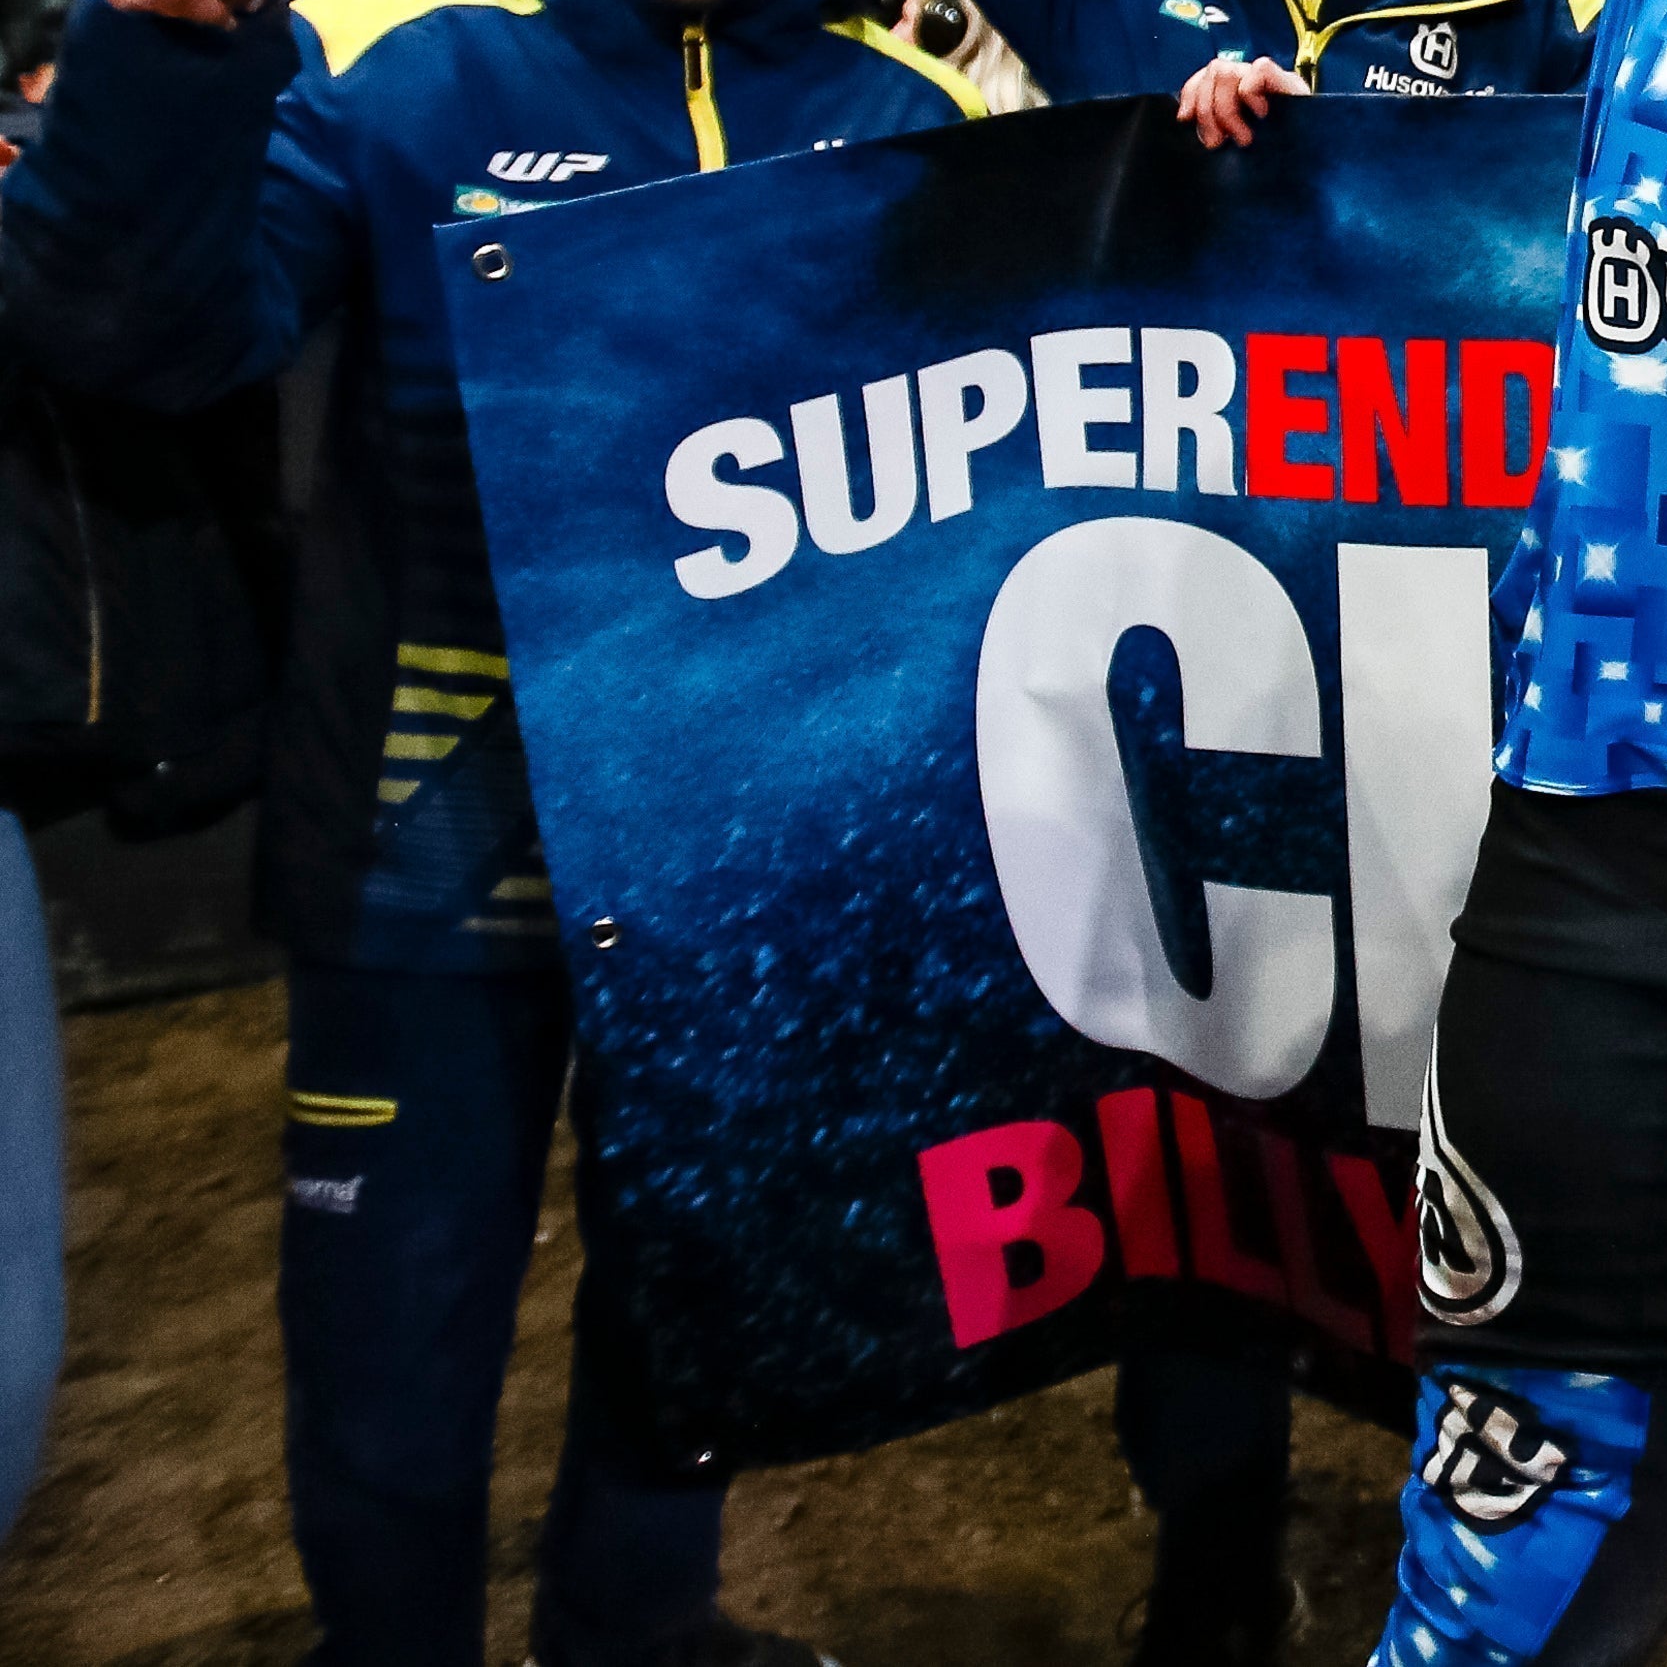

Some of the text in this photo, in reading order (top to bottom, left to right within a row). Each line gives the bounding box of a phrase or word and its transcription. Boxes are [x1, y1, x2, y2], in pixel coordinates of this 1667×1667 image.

[1364, 65, 1495, 96] Husqv
[486, 150, 612, 183] WP
[664, 327, 1556, 601] SUPEREND
[916, 1087, 1420, 1366] BILLY
